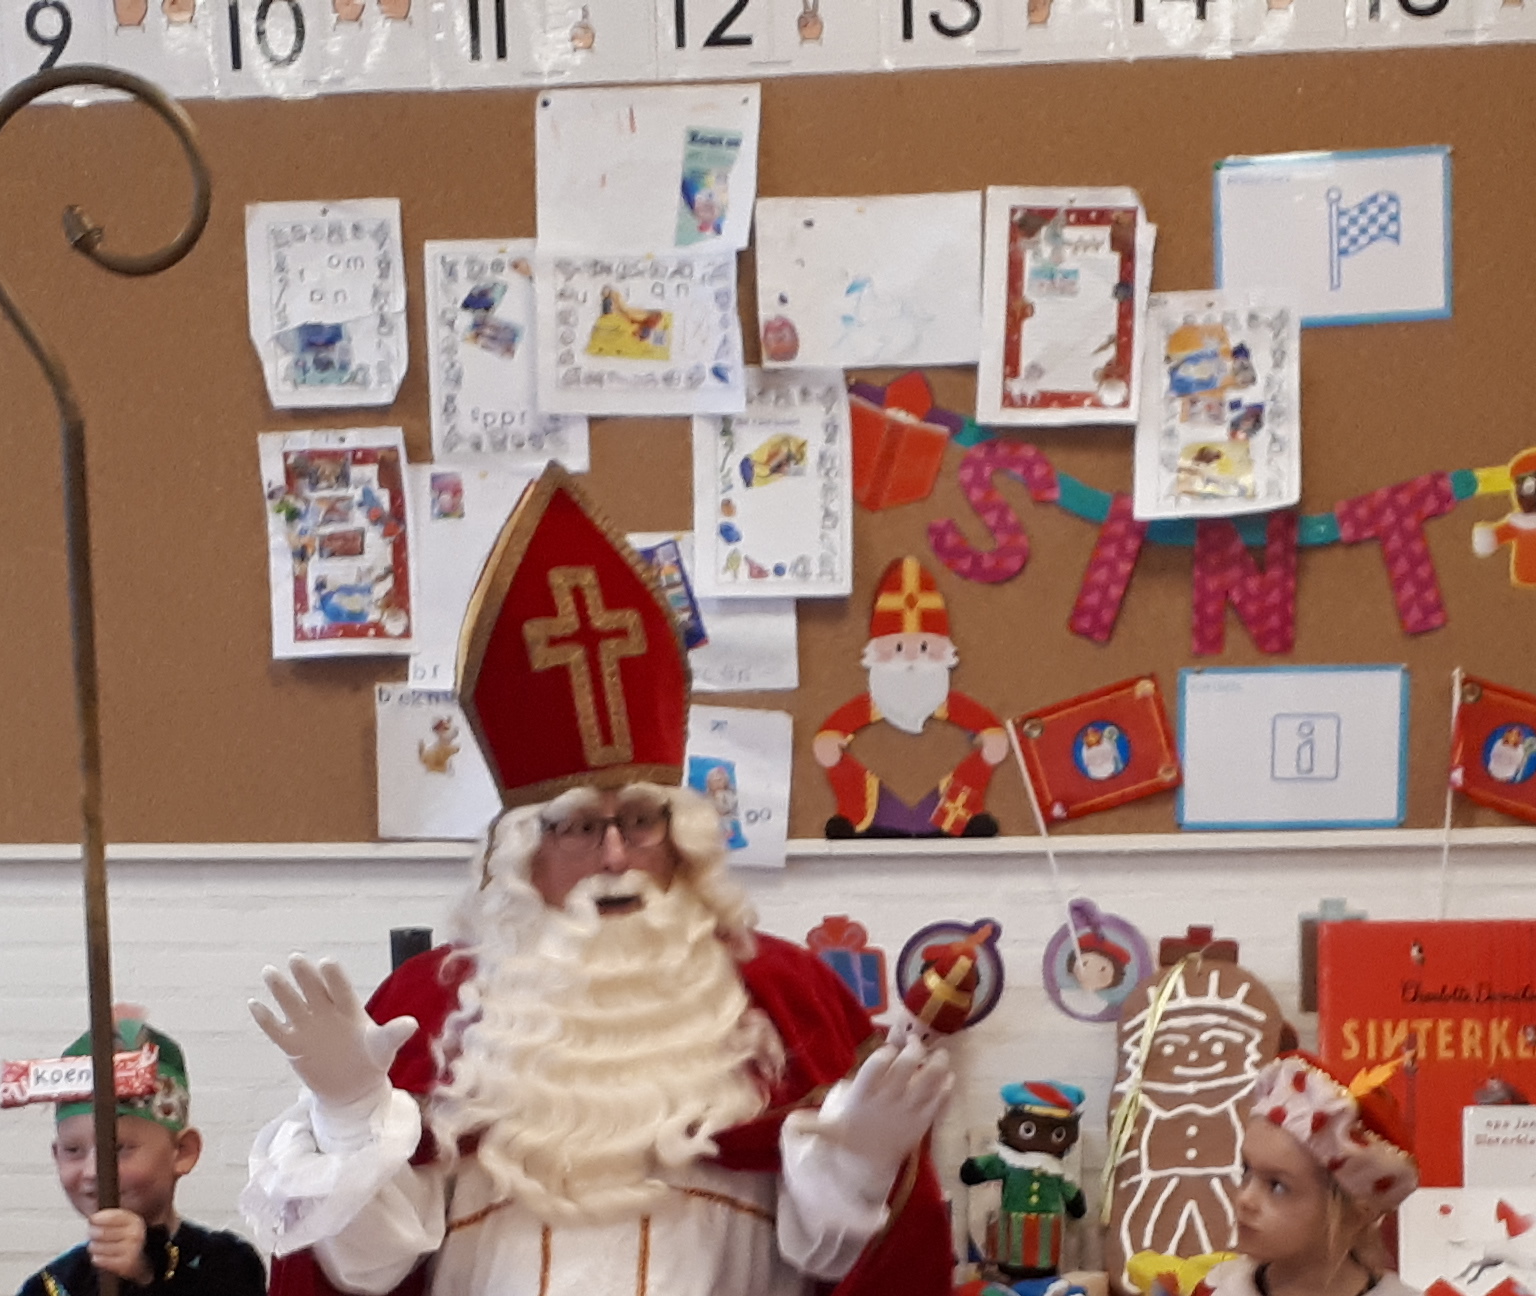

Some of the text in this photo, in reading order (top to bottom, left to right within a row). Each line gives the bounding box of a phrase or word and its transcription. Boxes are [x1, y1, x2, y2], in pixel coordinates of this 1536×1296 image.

[25, 0, 73, 71] 9
[229, 0, 307, 71] 10
[468, 0, 508, 61] 11
